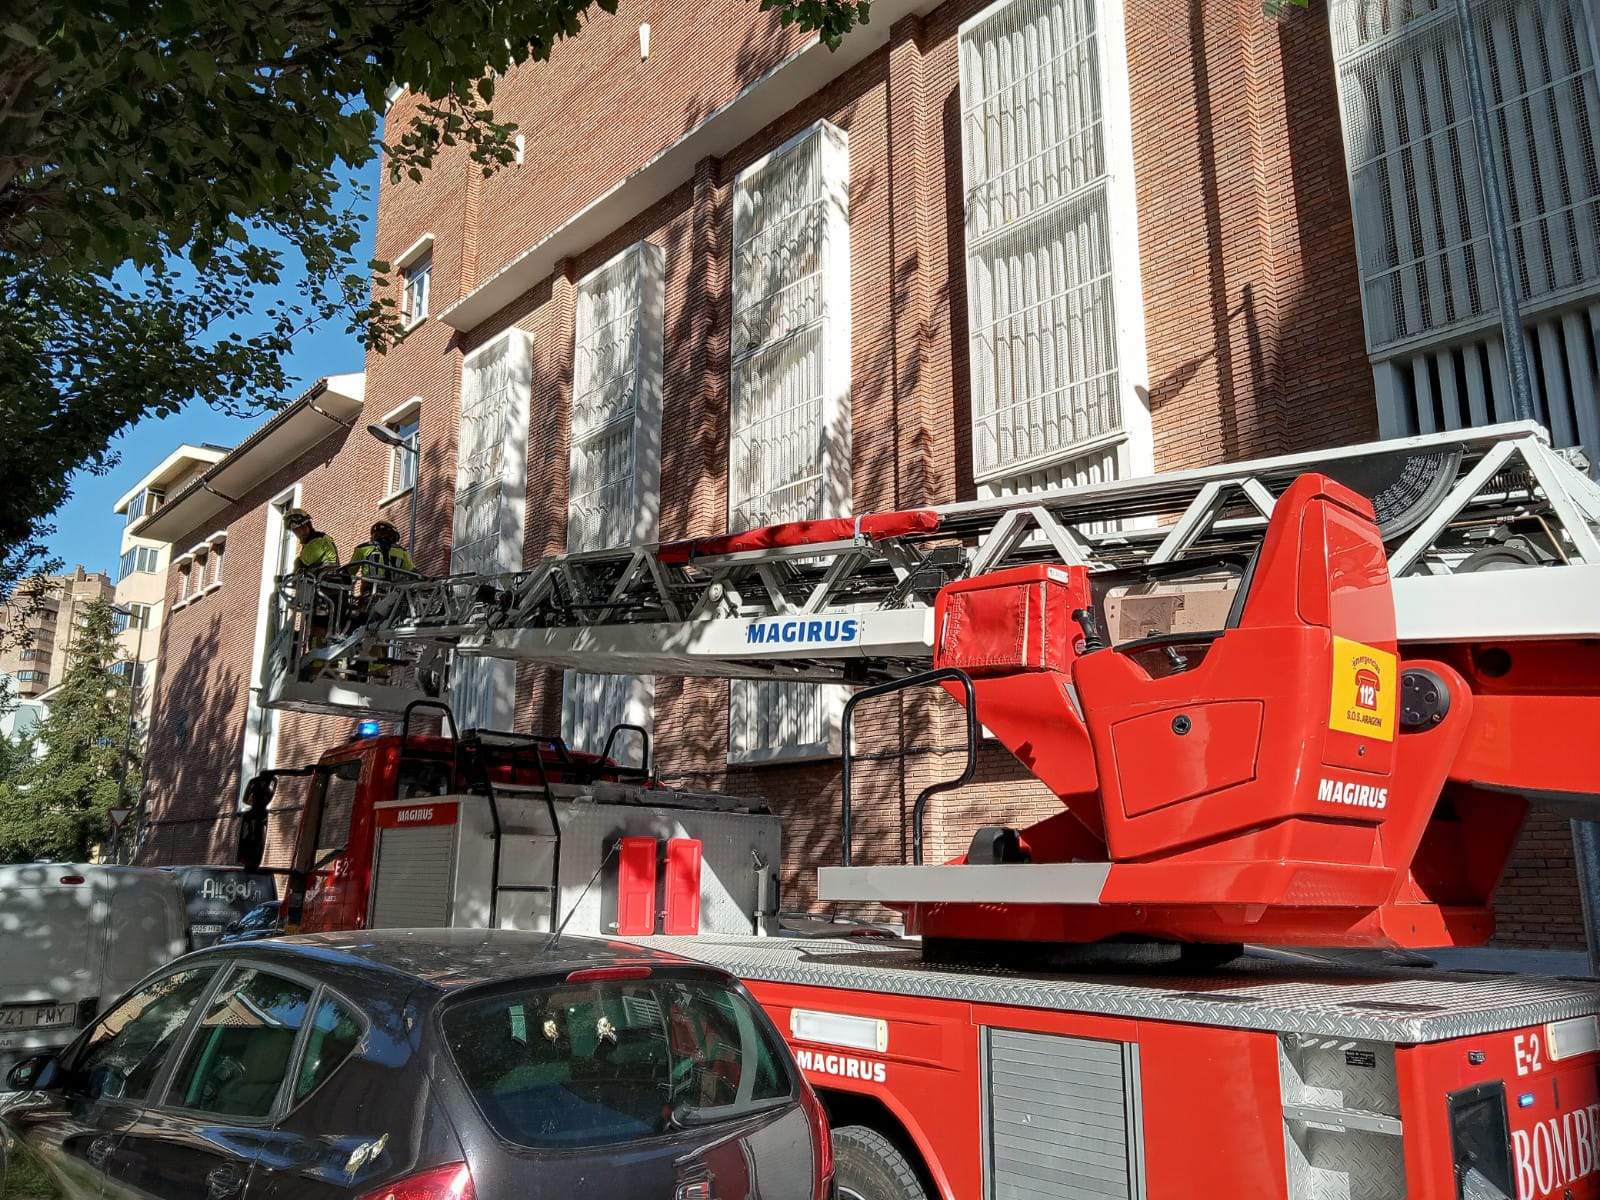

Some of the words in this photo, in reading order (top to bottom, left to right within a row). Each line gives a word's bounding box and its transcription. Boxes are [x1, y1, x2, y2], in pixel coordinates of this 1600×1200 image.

[747, 620, 857, 643] MAGIRUS
[1360, 684, 1374, 705] 112
[1318, 779, 1388, 809] MAGIRUS
[397, 808, 433, 822] MAGIRUS
[36, 1007, 66, 1024] FMY
[1513, 1033, 1542, 1076] E-2
[797, 1050, 887, 1083] MAGIRUS
